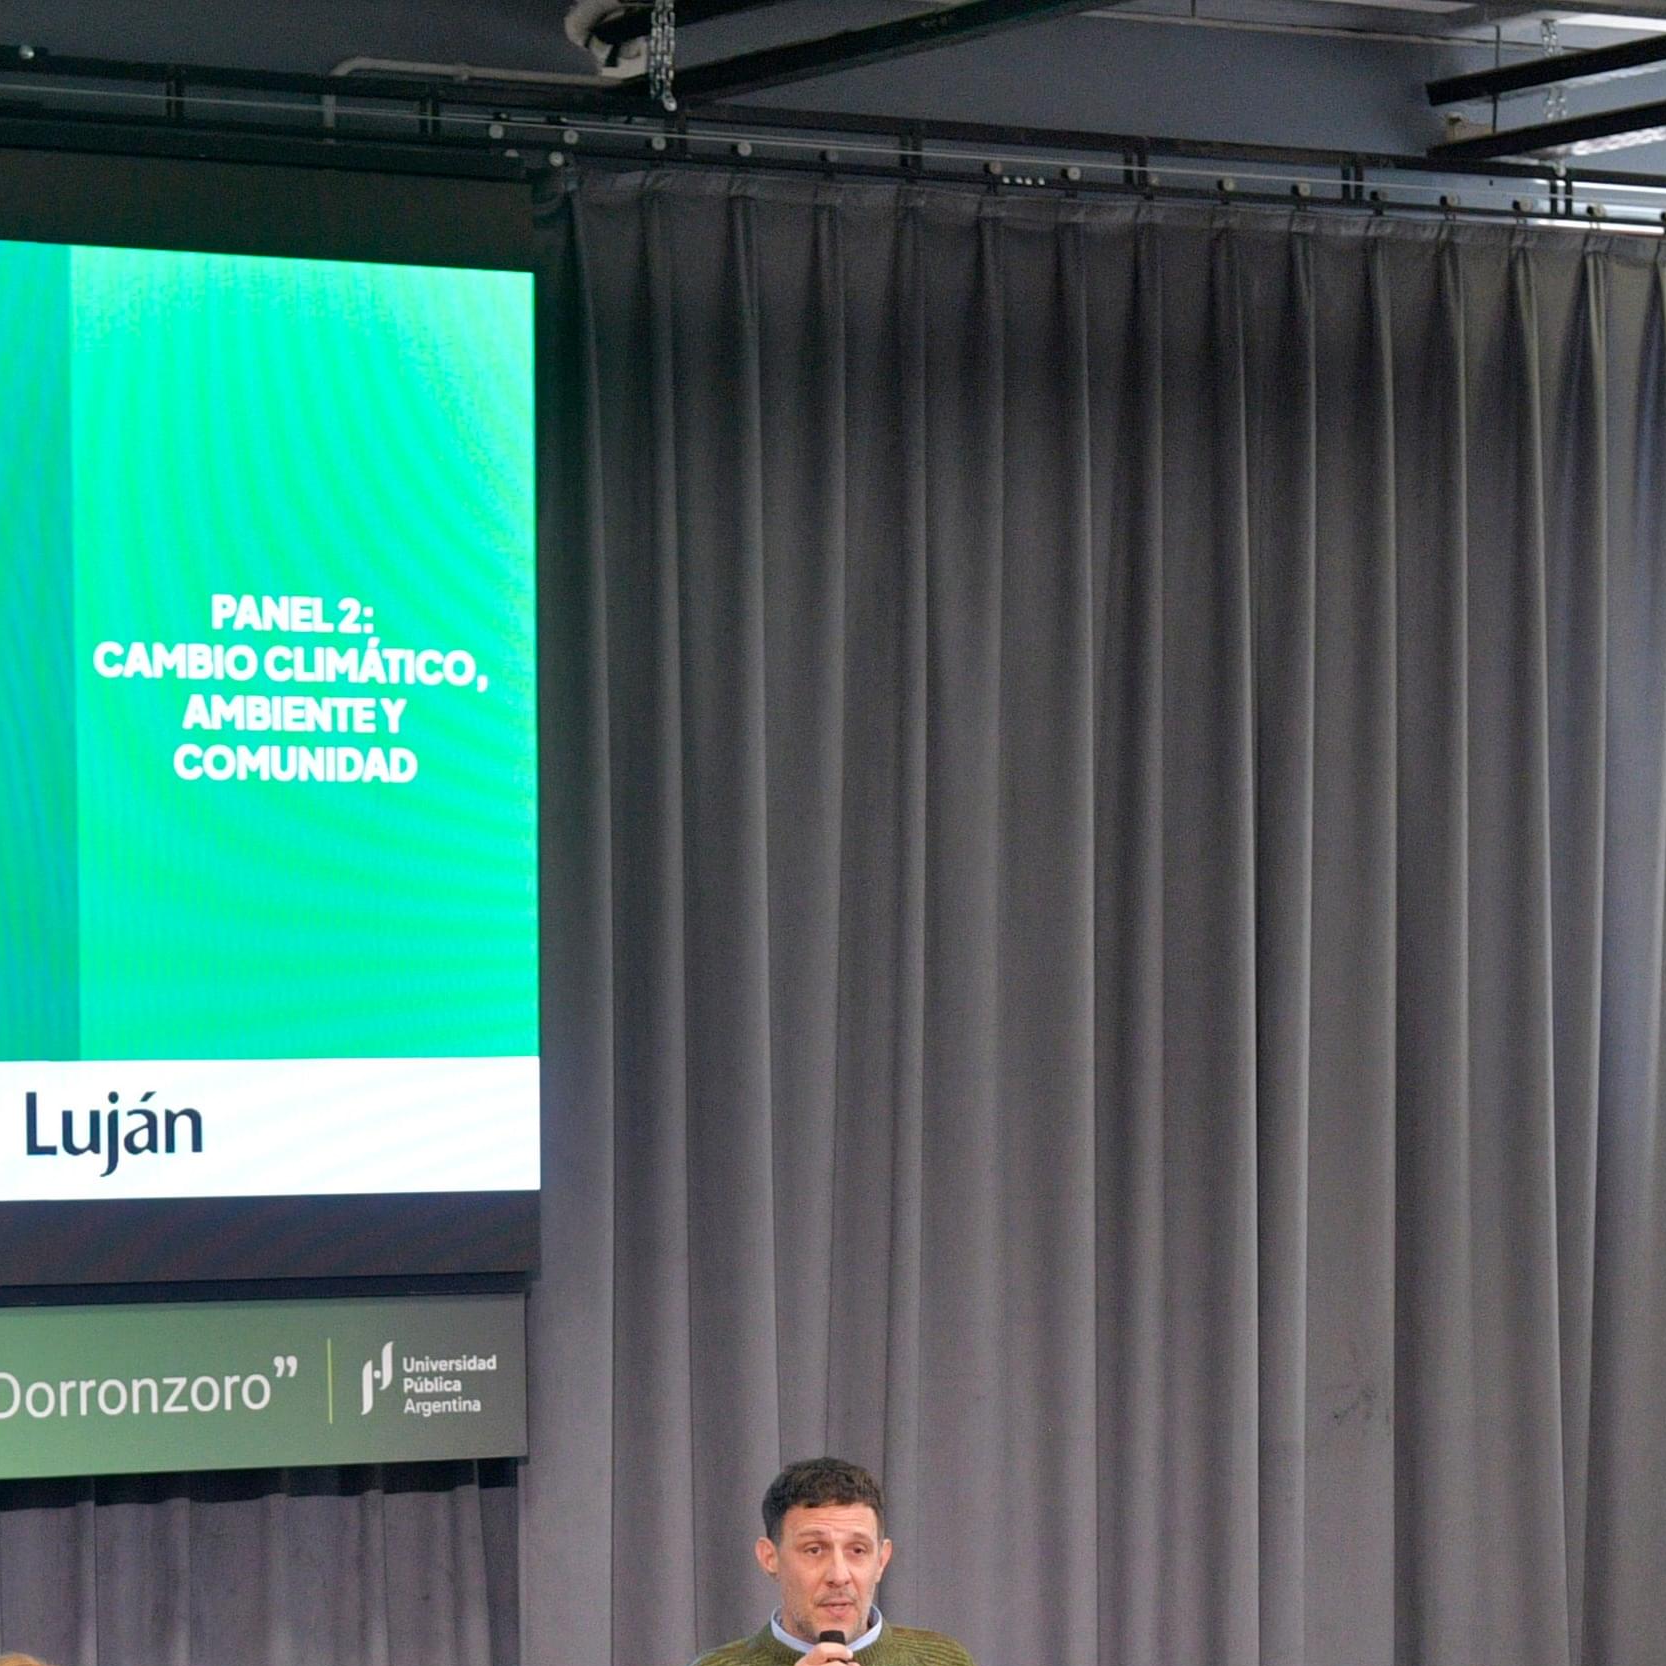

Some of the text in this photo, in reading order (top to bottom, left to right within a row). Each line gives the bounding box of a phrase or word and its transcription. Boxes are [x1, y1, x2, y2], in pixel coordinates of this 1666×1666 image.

[210, 592, 375, 635] PANEL 2:
[92, 636, 490, 693] CAMBIO CLIMÁTICO,
[181, 693, 408, 734] AMBIENTE Y
[172, 742, 419, 784] COMUNIDAD
[24, 1091, 203, 1178] Luján
[401, 1354, 497, 1374] Universidad
[402, 1375, 463, 1394] Pública
[403, 1395, 482, 1418] Argentina
